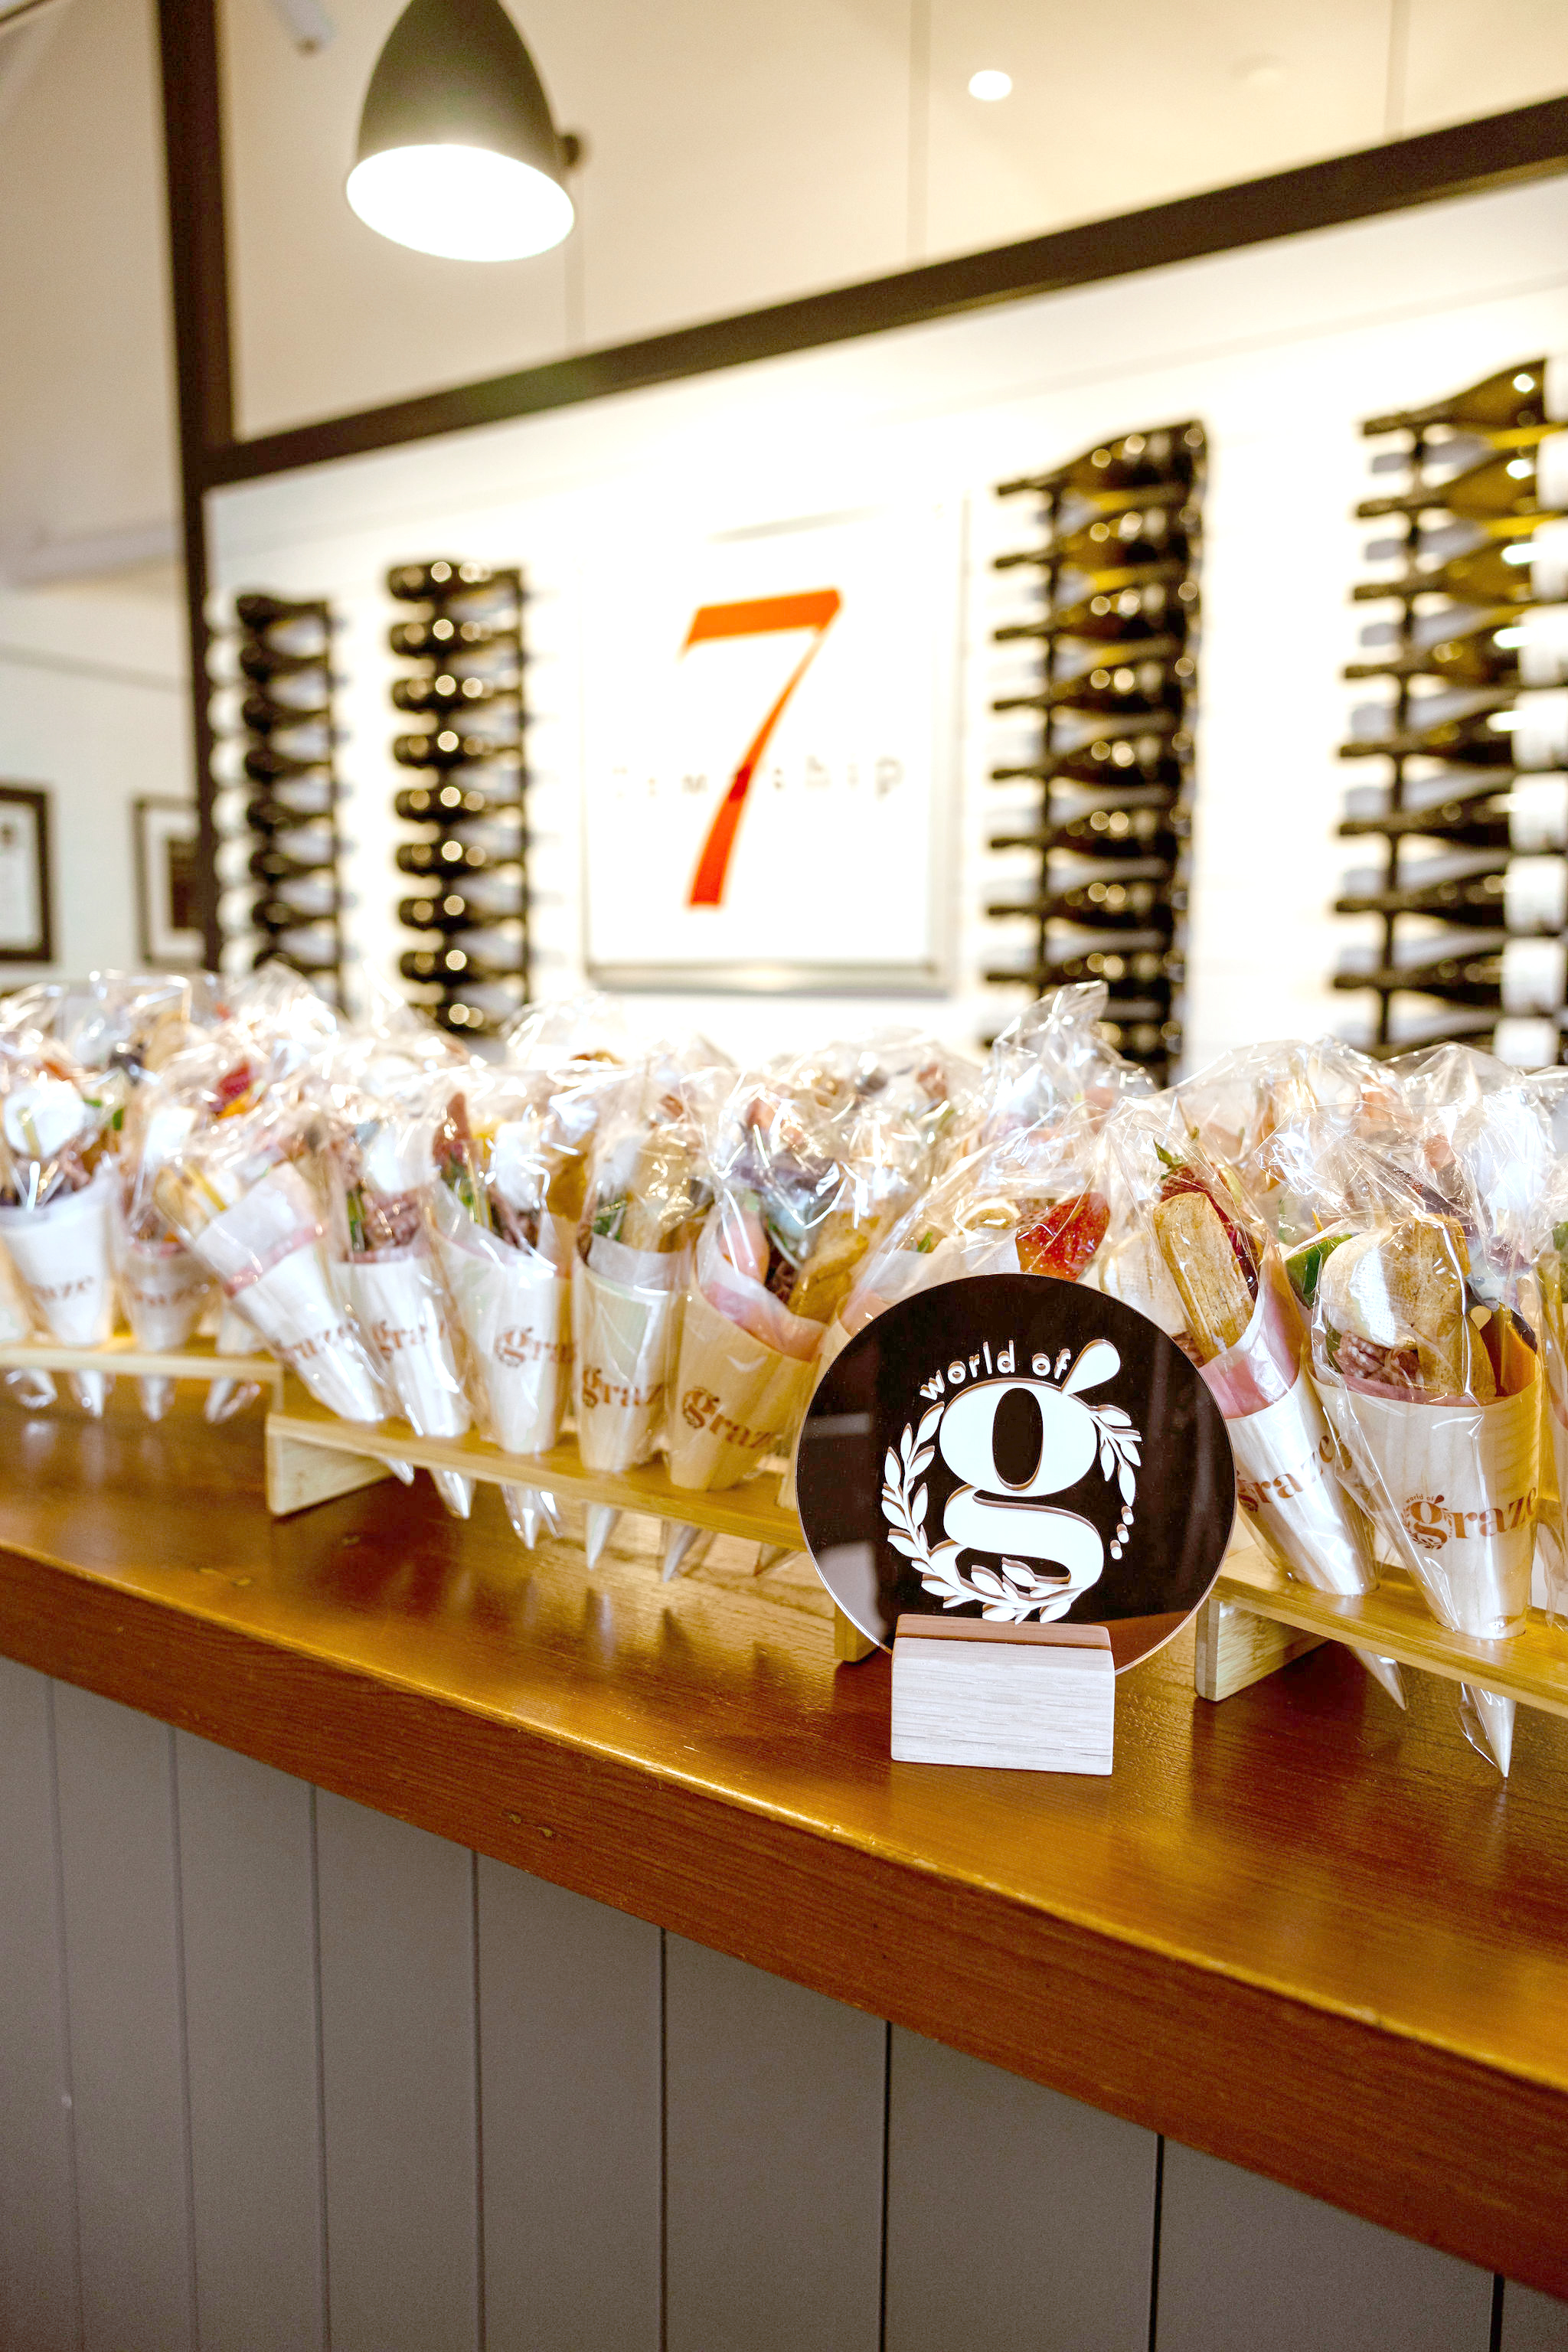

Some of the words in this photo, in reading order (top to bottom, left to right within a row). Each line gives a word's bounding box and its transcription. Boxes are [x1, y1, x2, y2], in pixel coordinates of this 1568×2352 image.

[677, 586, 841, 910] 7
[920, 1340, 1016, 1400] world
[1032, 1348, 1071, 1380] of
